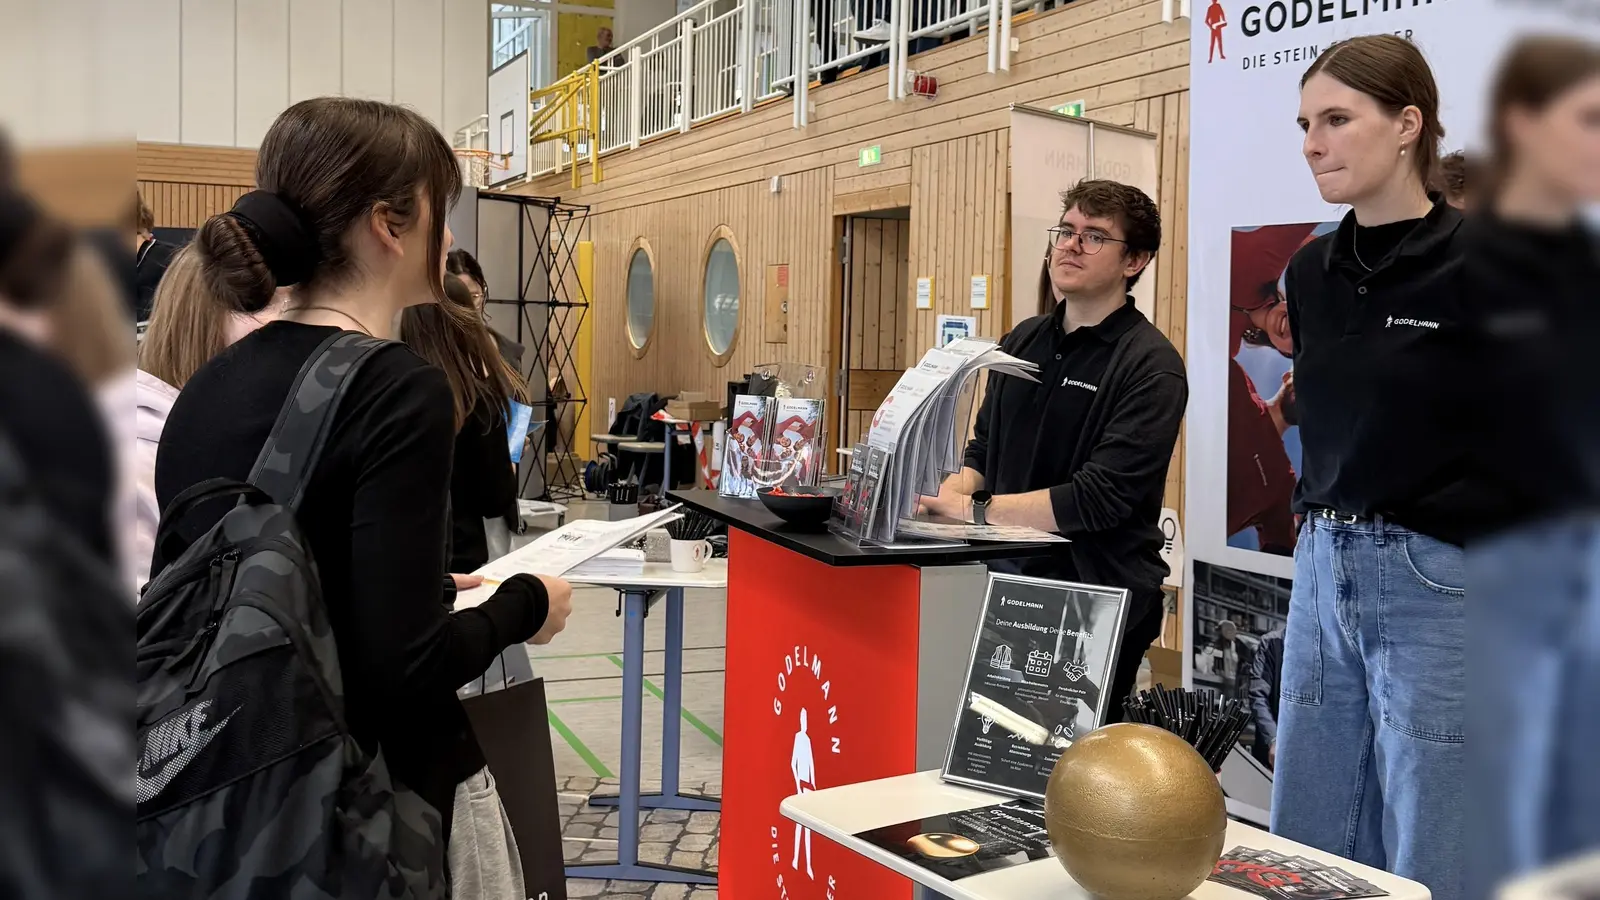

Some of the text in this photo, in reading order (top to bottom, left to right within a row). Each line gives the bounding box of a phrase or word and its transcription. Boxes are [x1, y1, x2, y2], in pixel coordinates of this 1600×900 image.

[1242, 54, 1267, 70] DIE
[1006, 599, 1044, 609] GODELMANN
[995, 618, 1013, 627] Deine
[1012, 621, 1048, 634] Ausbildung
[1066, 629, 1094, 640] Benefits
[773, 645, 841, 753] GODELMANN
[142, 699, 213, 771] NIKE
[990, 809, 1048, 837] Gewinnsp
[770, 826, 780, 864] DIE
